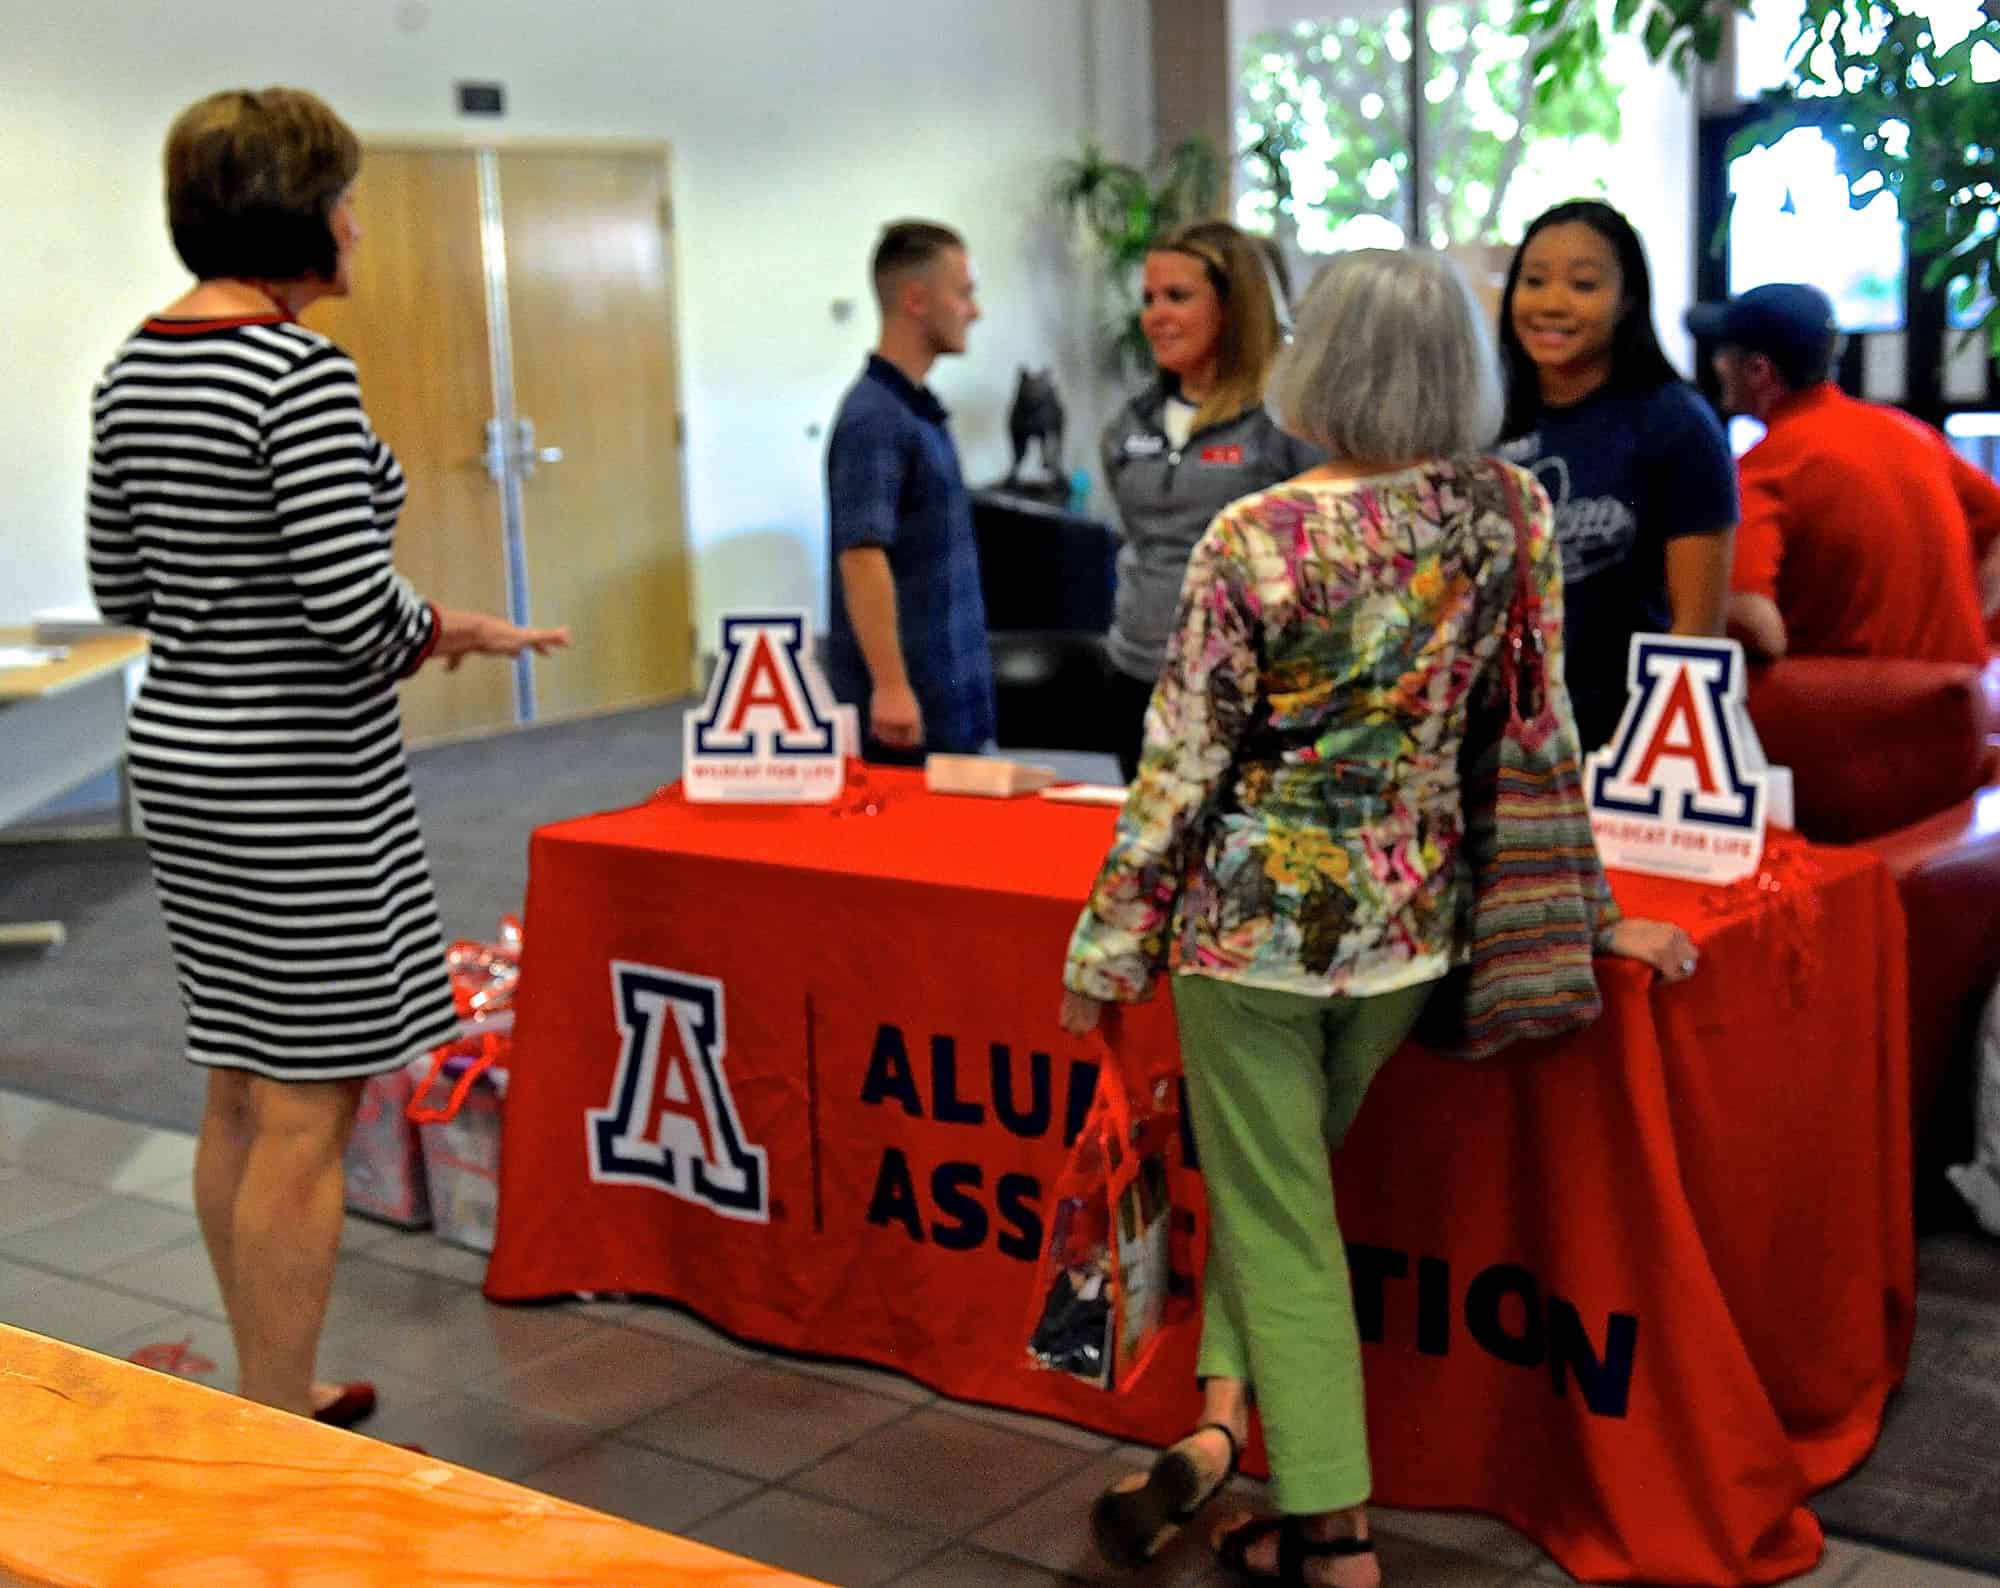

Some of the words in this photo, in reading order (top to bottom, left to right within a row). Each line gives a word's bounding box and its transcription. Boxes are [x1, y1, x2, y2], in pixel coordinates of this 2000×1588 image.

[696, 617, 834, 755] A
[1592, 643, 1757, 829] A
[589, 964, 767, 1219] A
